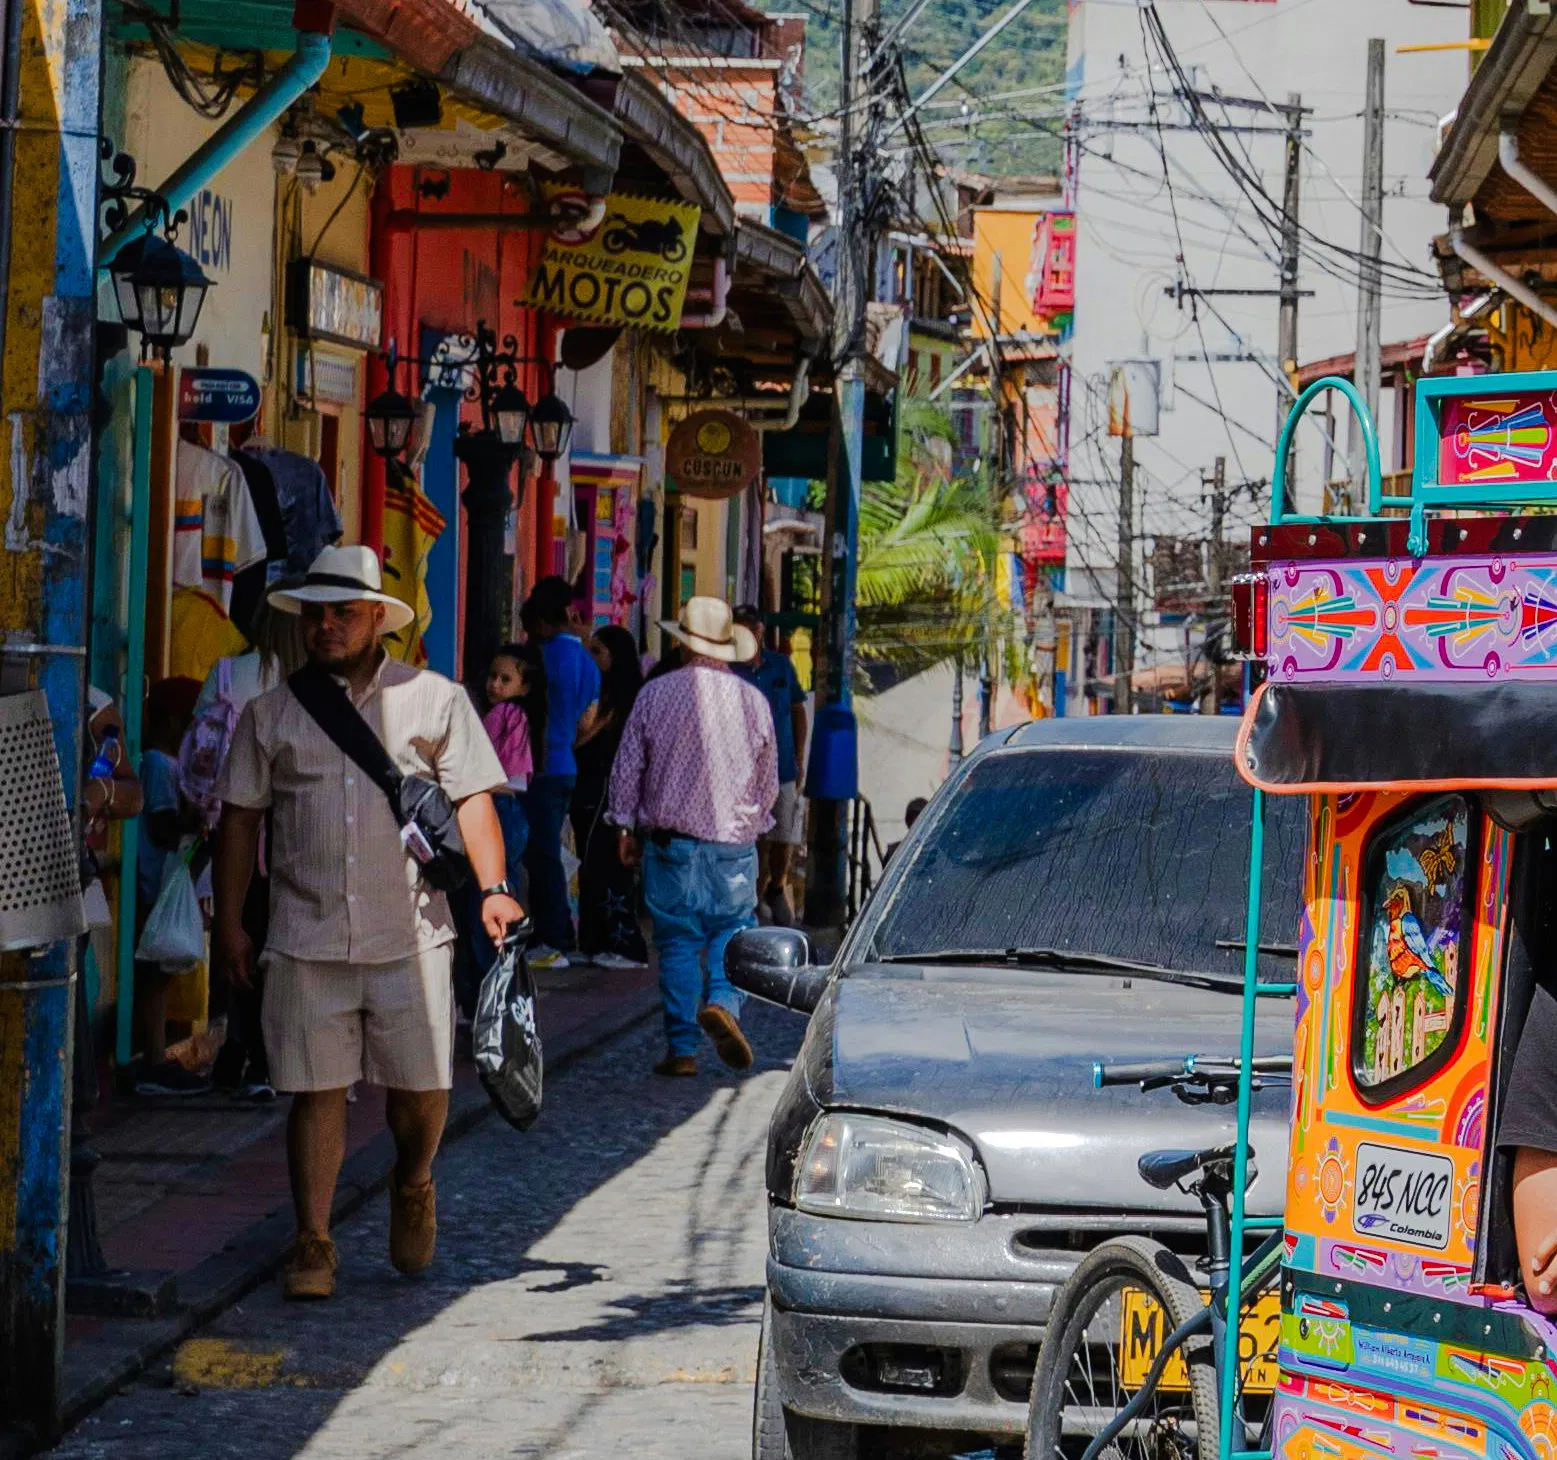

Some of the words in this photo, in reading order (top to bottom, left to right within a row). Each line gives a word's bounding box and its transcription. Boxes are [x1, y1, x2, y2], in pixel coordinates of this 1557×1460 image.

[544, 249, 683, 285] ARQUEADERO
[531, 264, 673, 322] MOTOS
[227, 394, 254, 405] VISA
[1357, 1164, 1402, 1211] 845
[1395, 1170, 1449, 1217] NCC
[1389, 1223, 1443, 1241] Colombia
